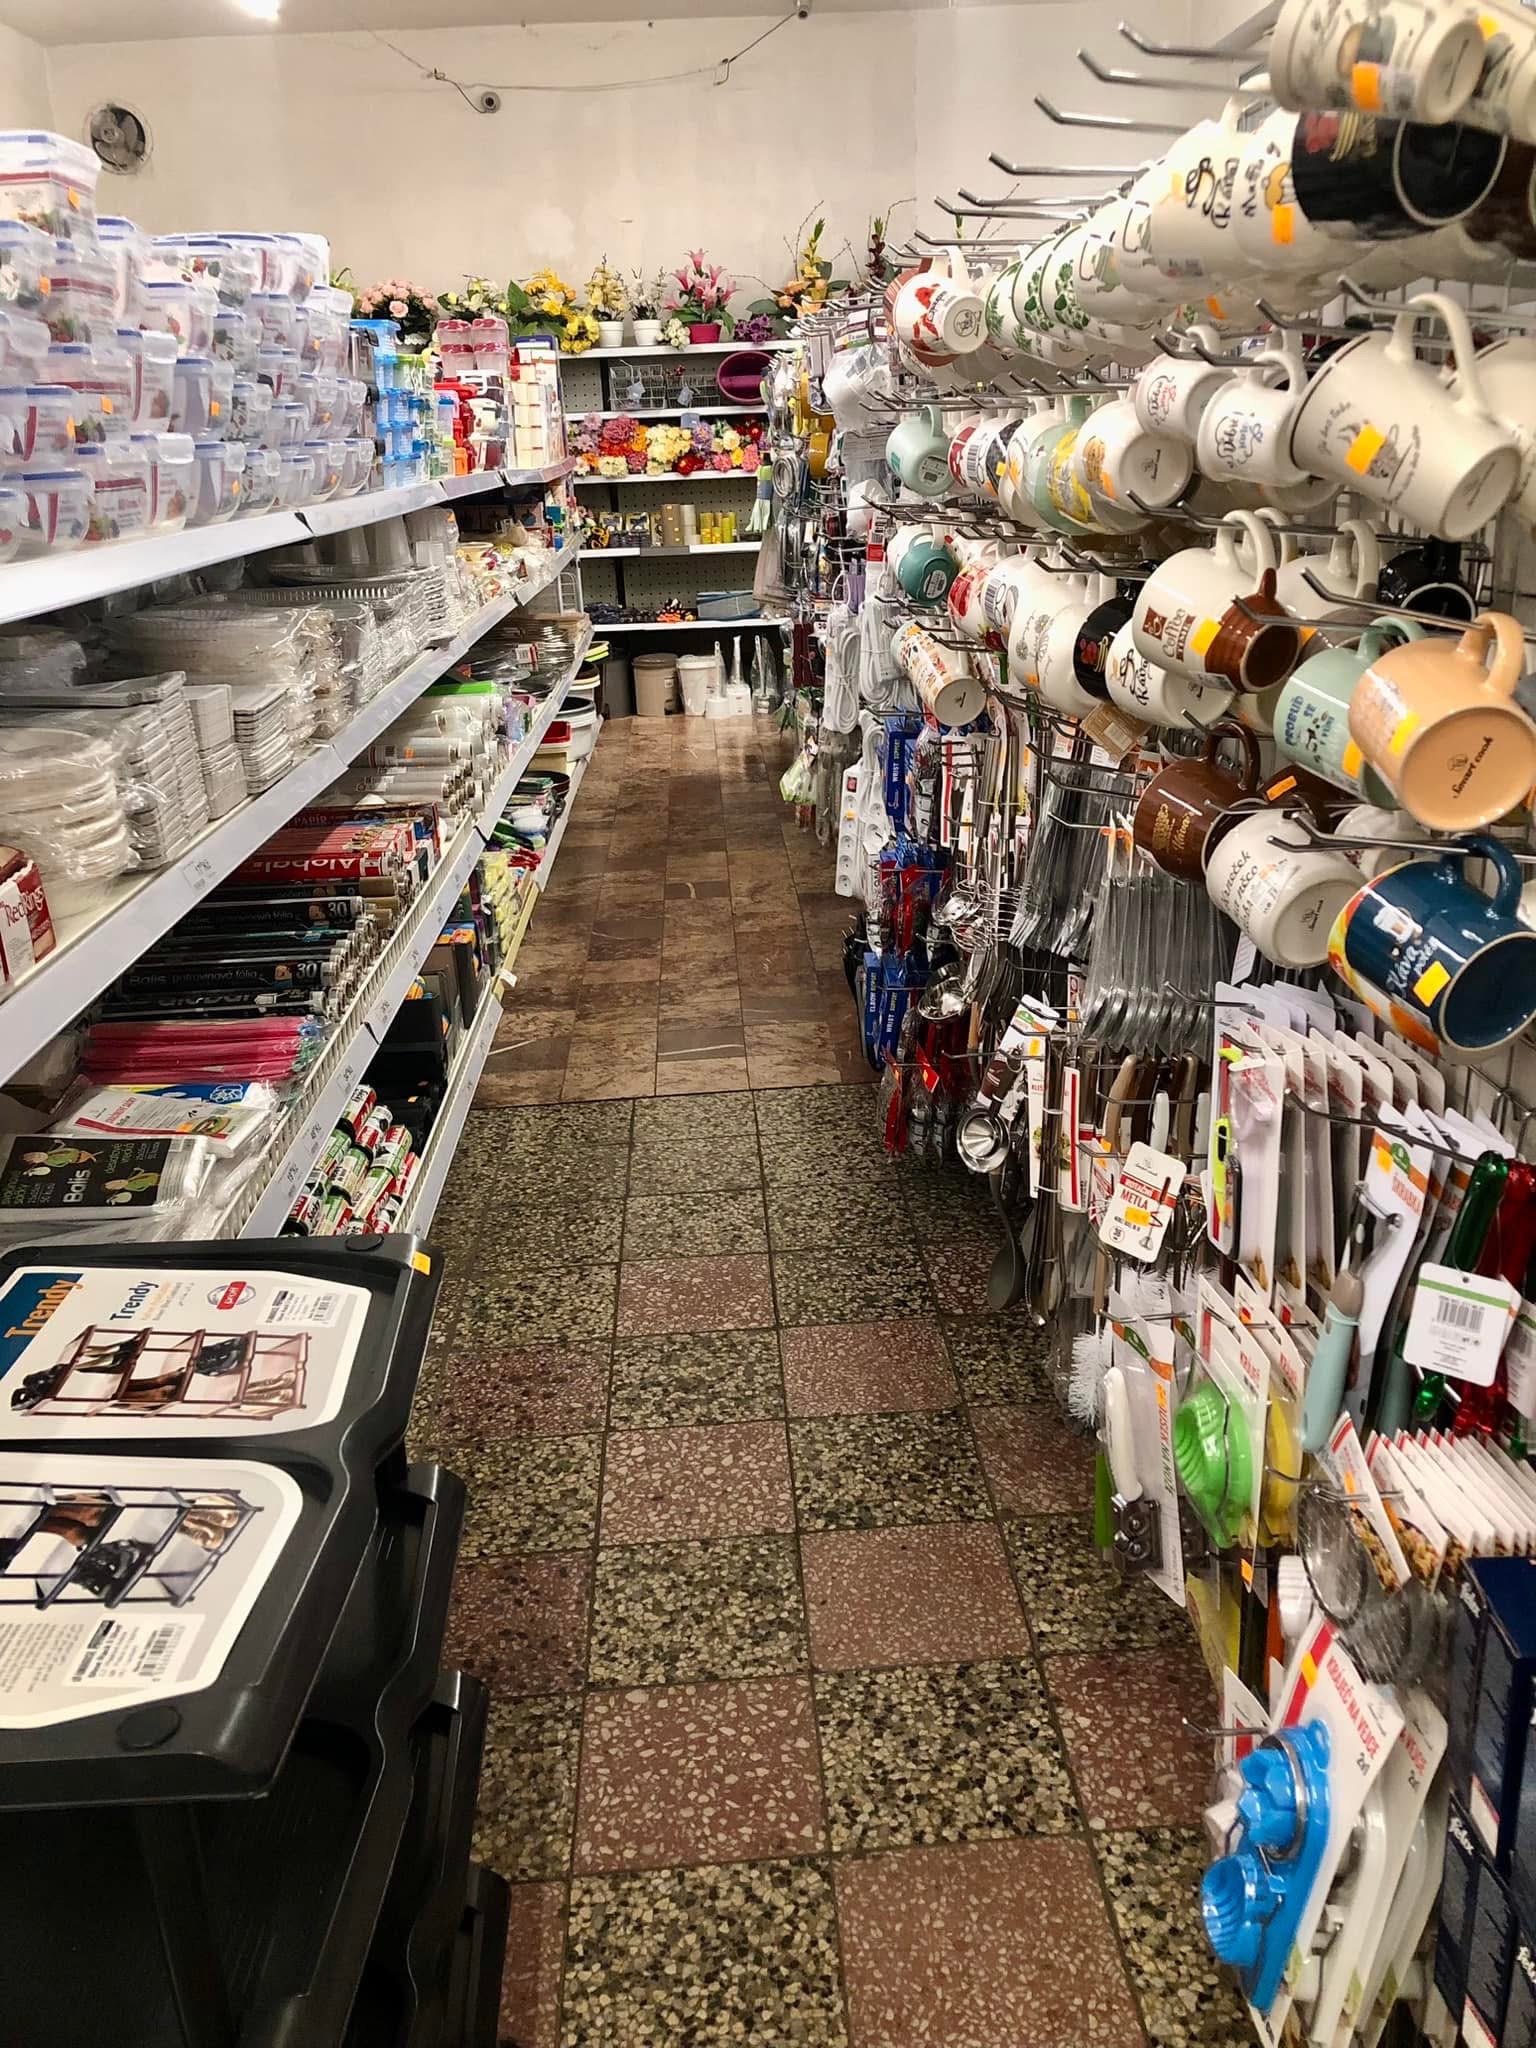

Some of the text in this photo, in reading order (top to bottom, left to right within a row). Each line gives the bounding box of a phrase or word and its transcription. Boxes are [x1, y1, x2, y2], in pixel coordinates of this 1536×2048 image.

[1162, 608, 1185, 658] Coffee
[328, 900, 348, 919] 30
[296, 962, 318, 980] 30
[63, 1169, 92, 1203] Balis
[1121, 1189, 1149, 1210] METLA
[4, 1279, 84, 1339] Trendy
[110, 1281, 160, 1321] Trendy
